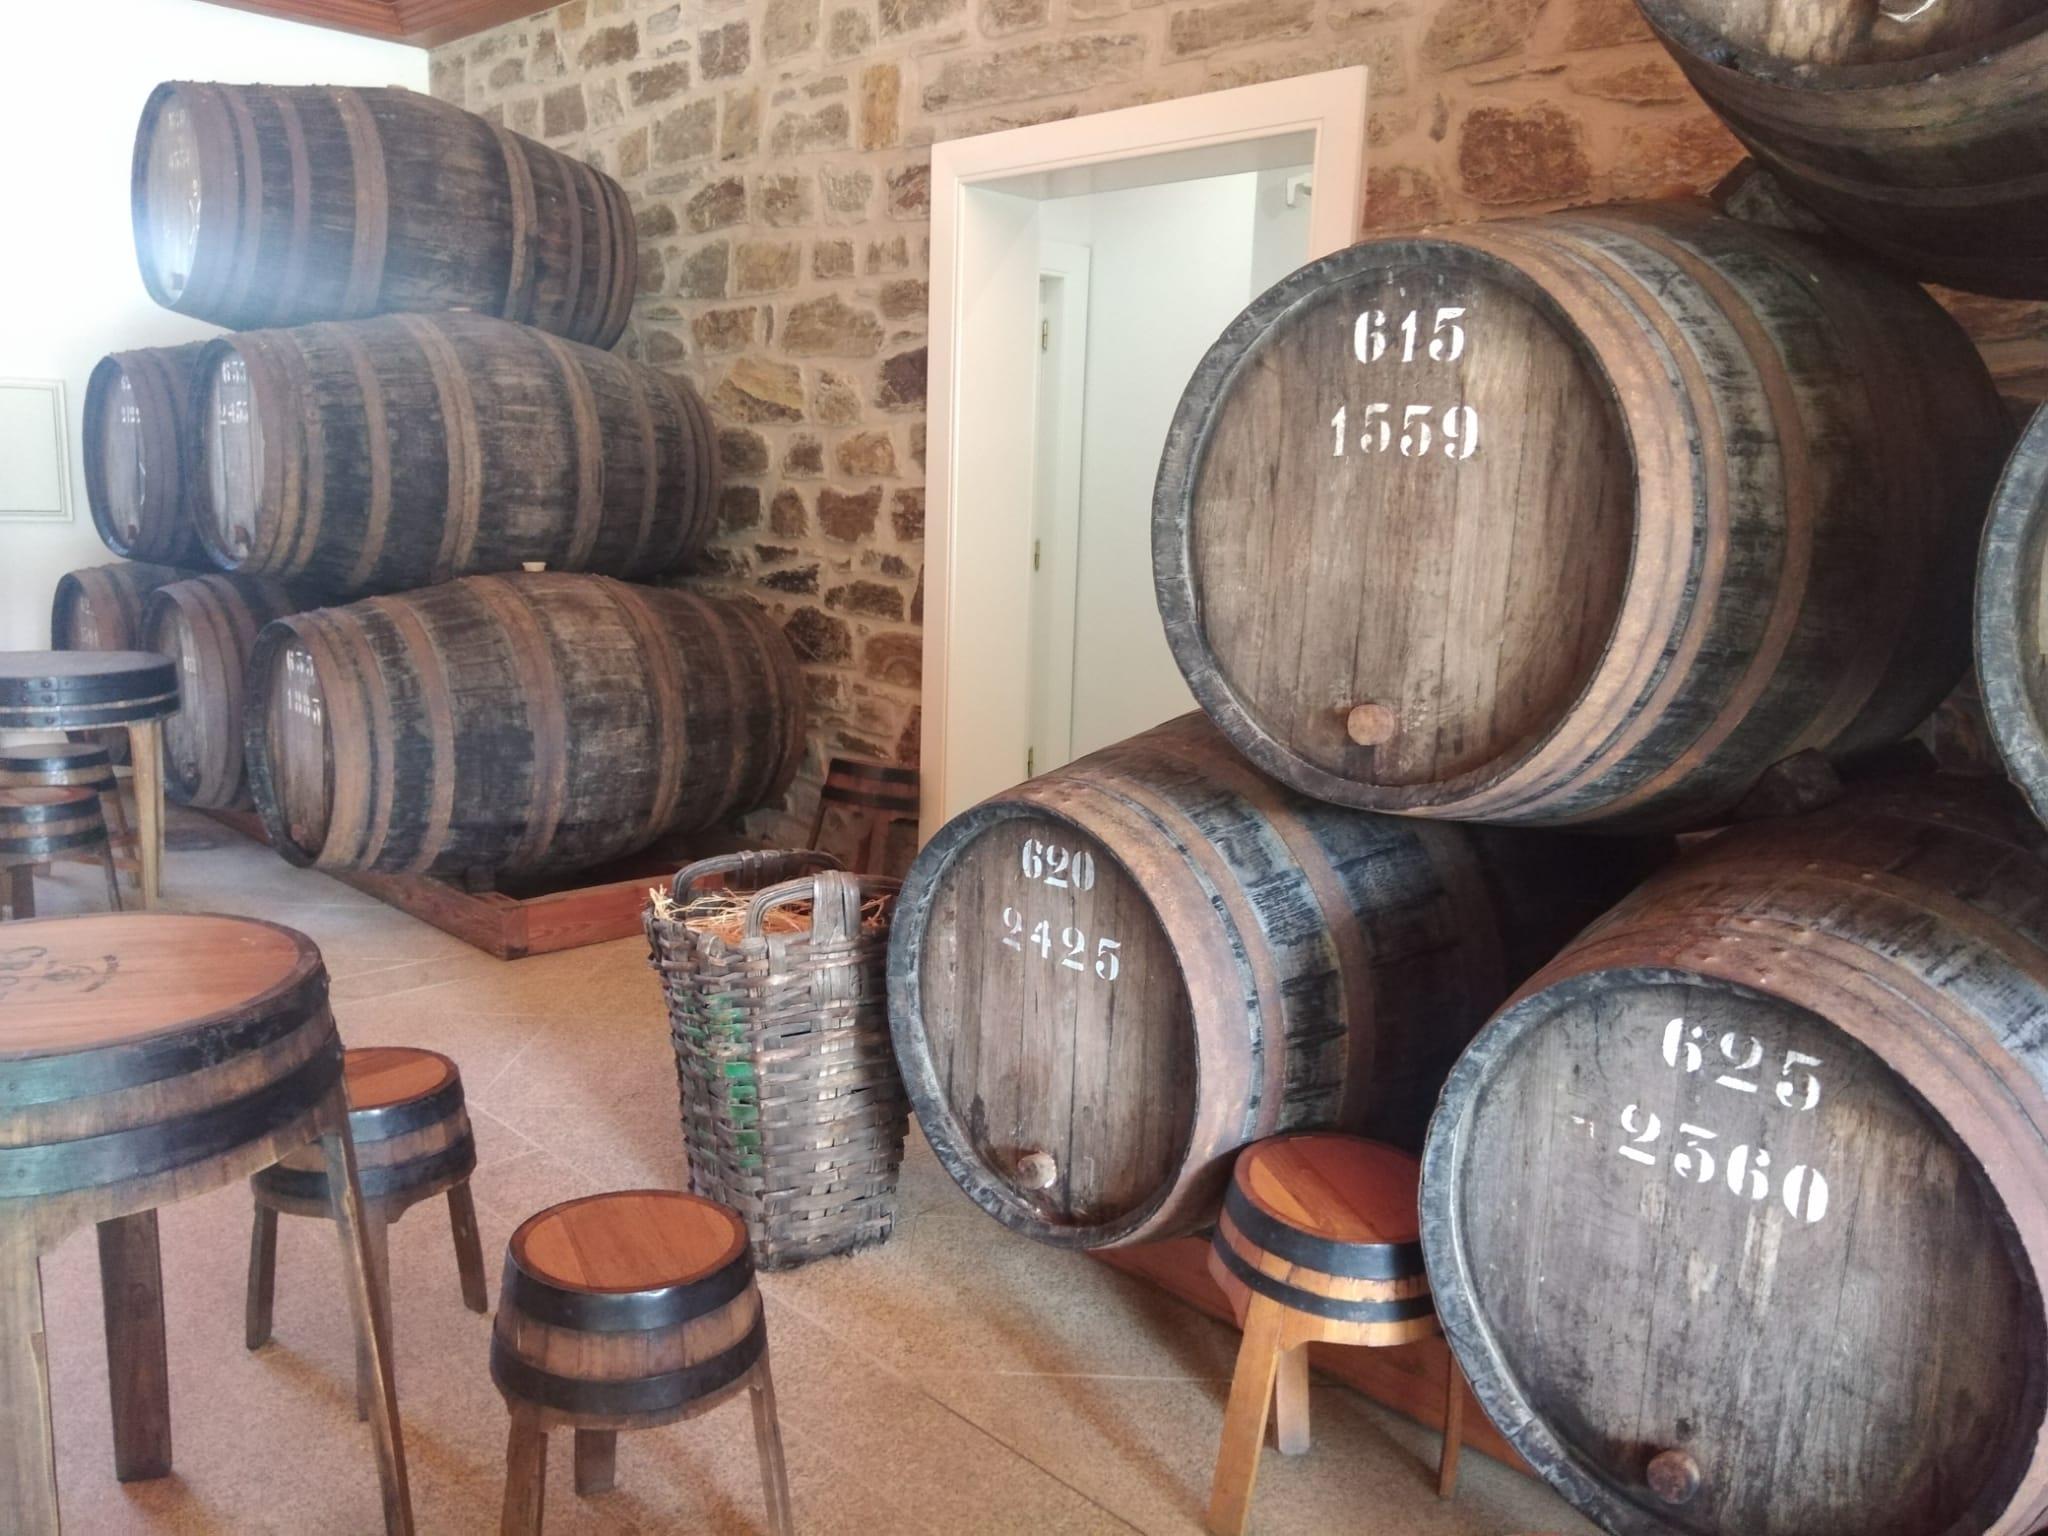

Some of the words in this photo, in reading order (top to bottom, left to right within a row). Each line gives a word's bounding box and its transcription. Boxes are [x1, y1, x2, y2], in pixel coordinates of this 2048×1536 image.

[1354, 307, 1466, 364] 615
[1331, 403, 1479, 460] 1559
[1022, 838, 1095, 891] 620
[1003, 907, 1122, 981] 2425
[1662, 1018, 1825, 1111] 625
